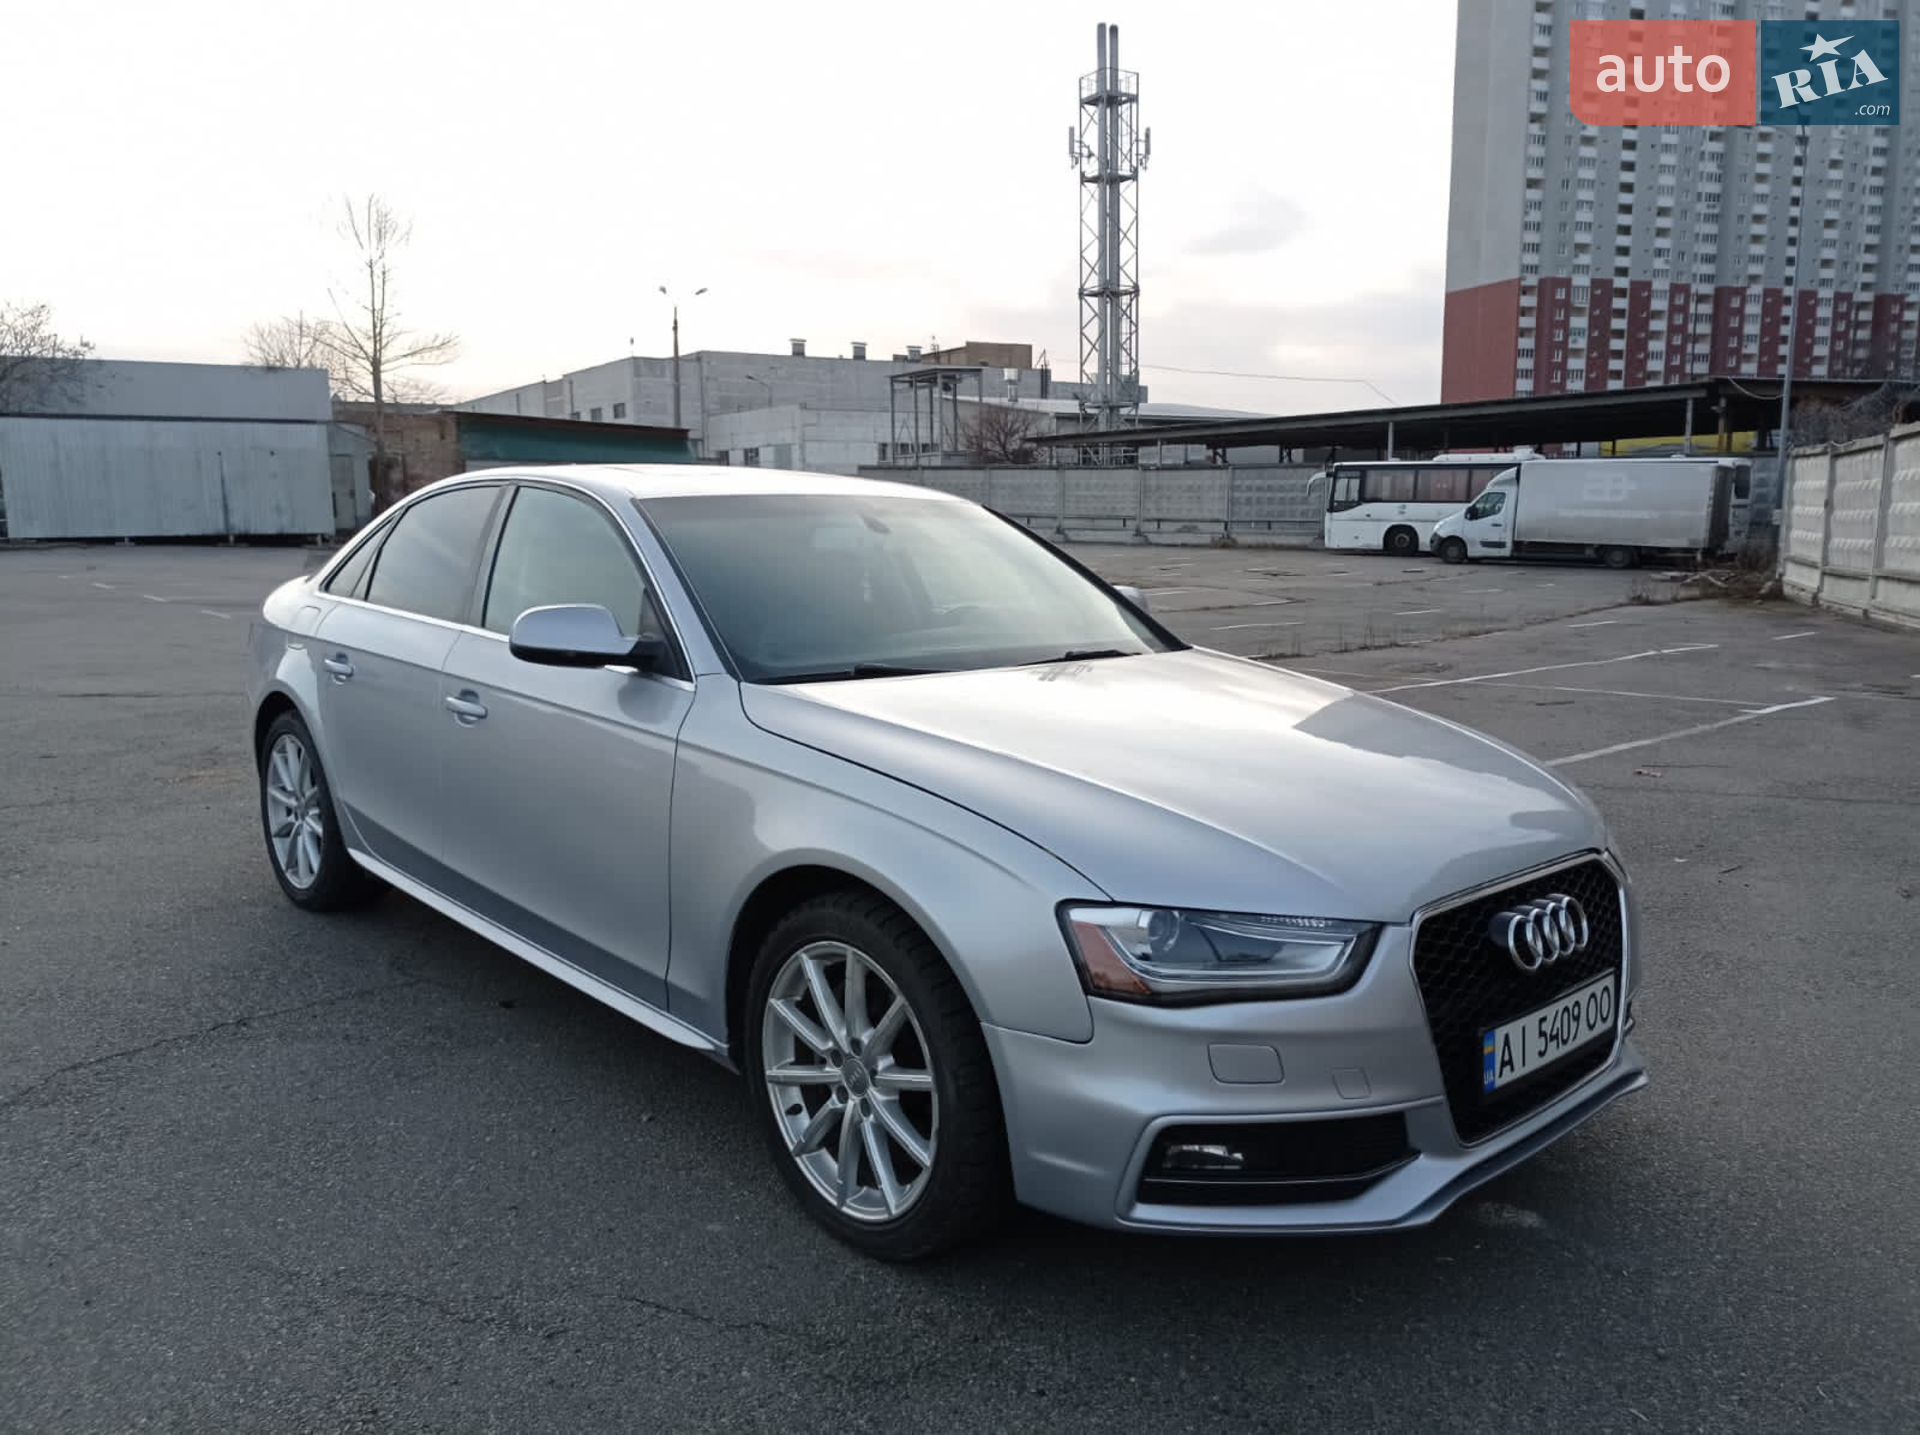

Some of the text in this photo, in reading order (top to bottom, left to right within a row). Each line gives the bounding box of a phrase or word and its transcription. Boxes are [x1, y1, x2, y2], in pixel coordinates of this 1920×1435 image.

[1498, 985, 1611, 1079] AI 5409 OO
